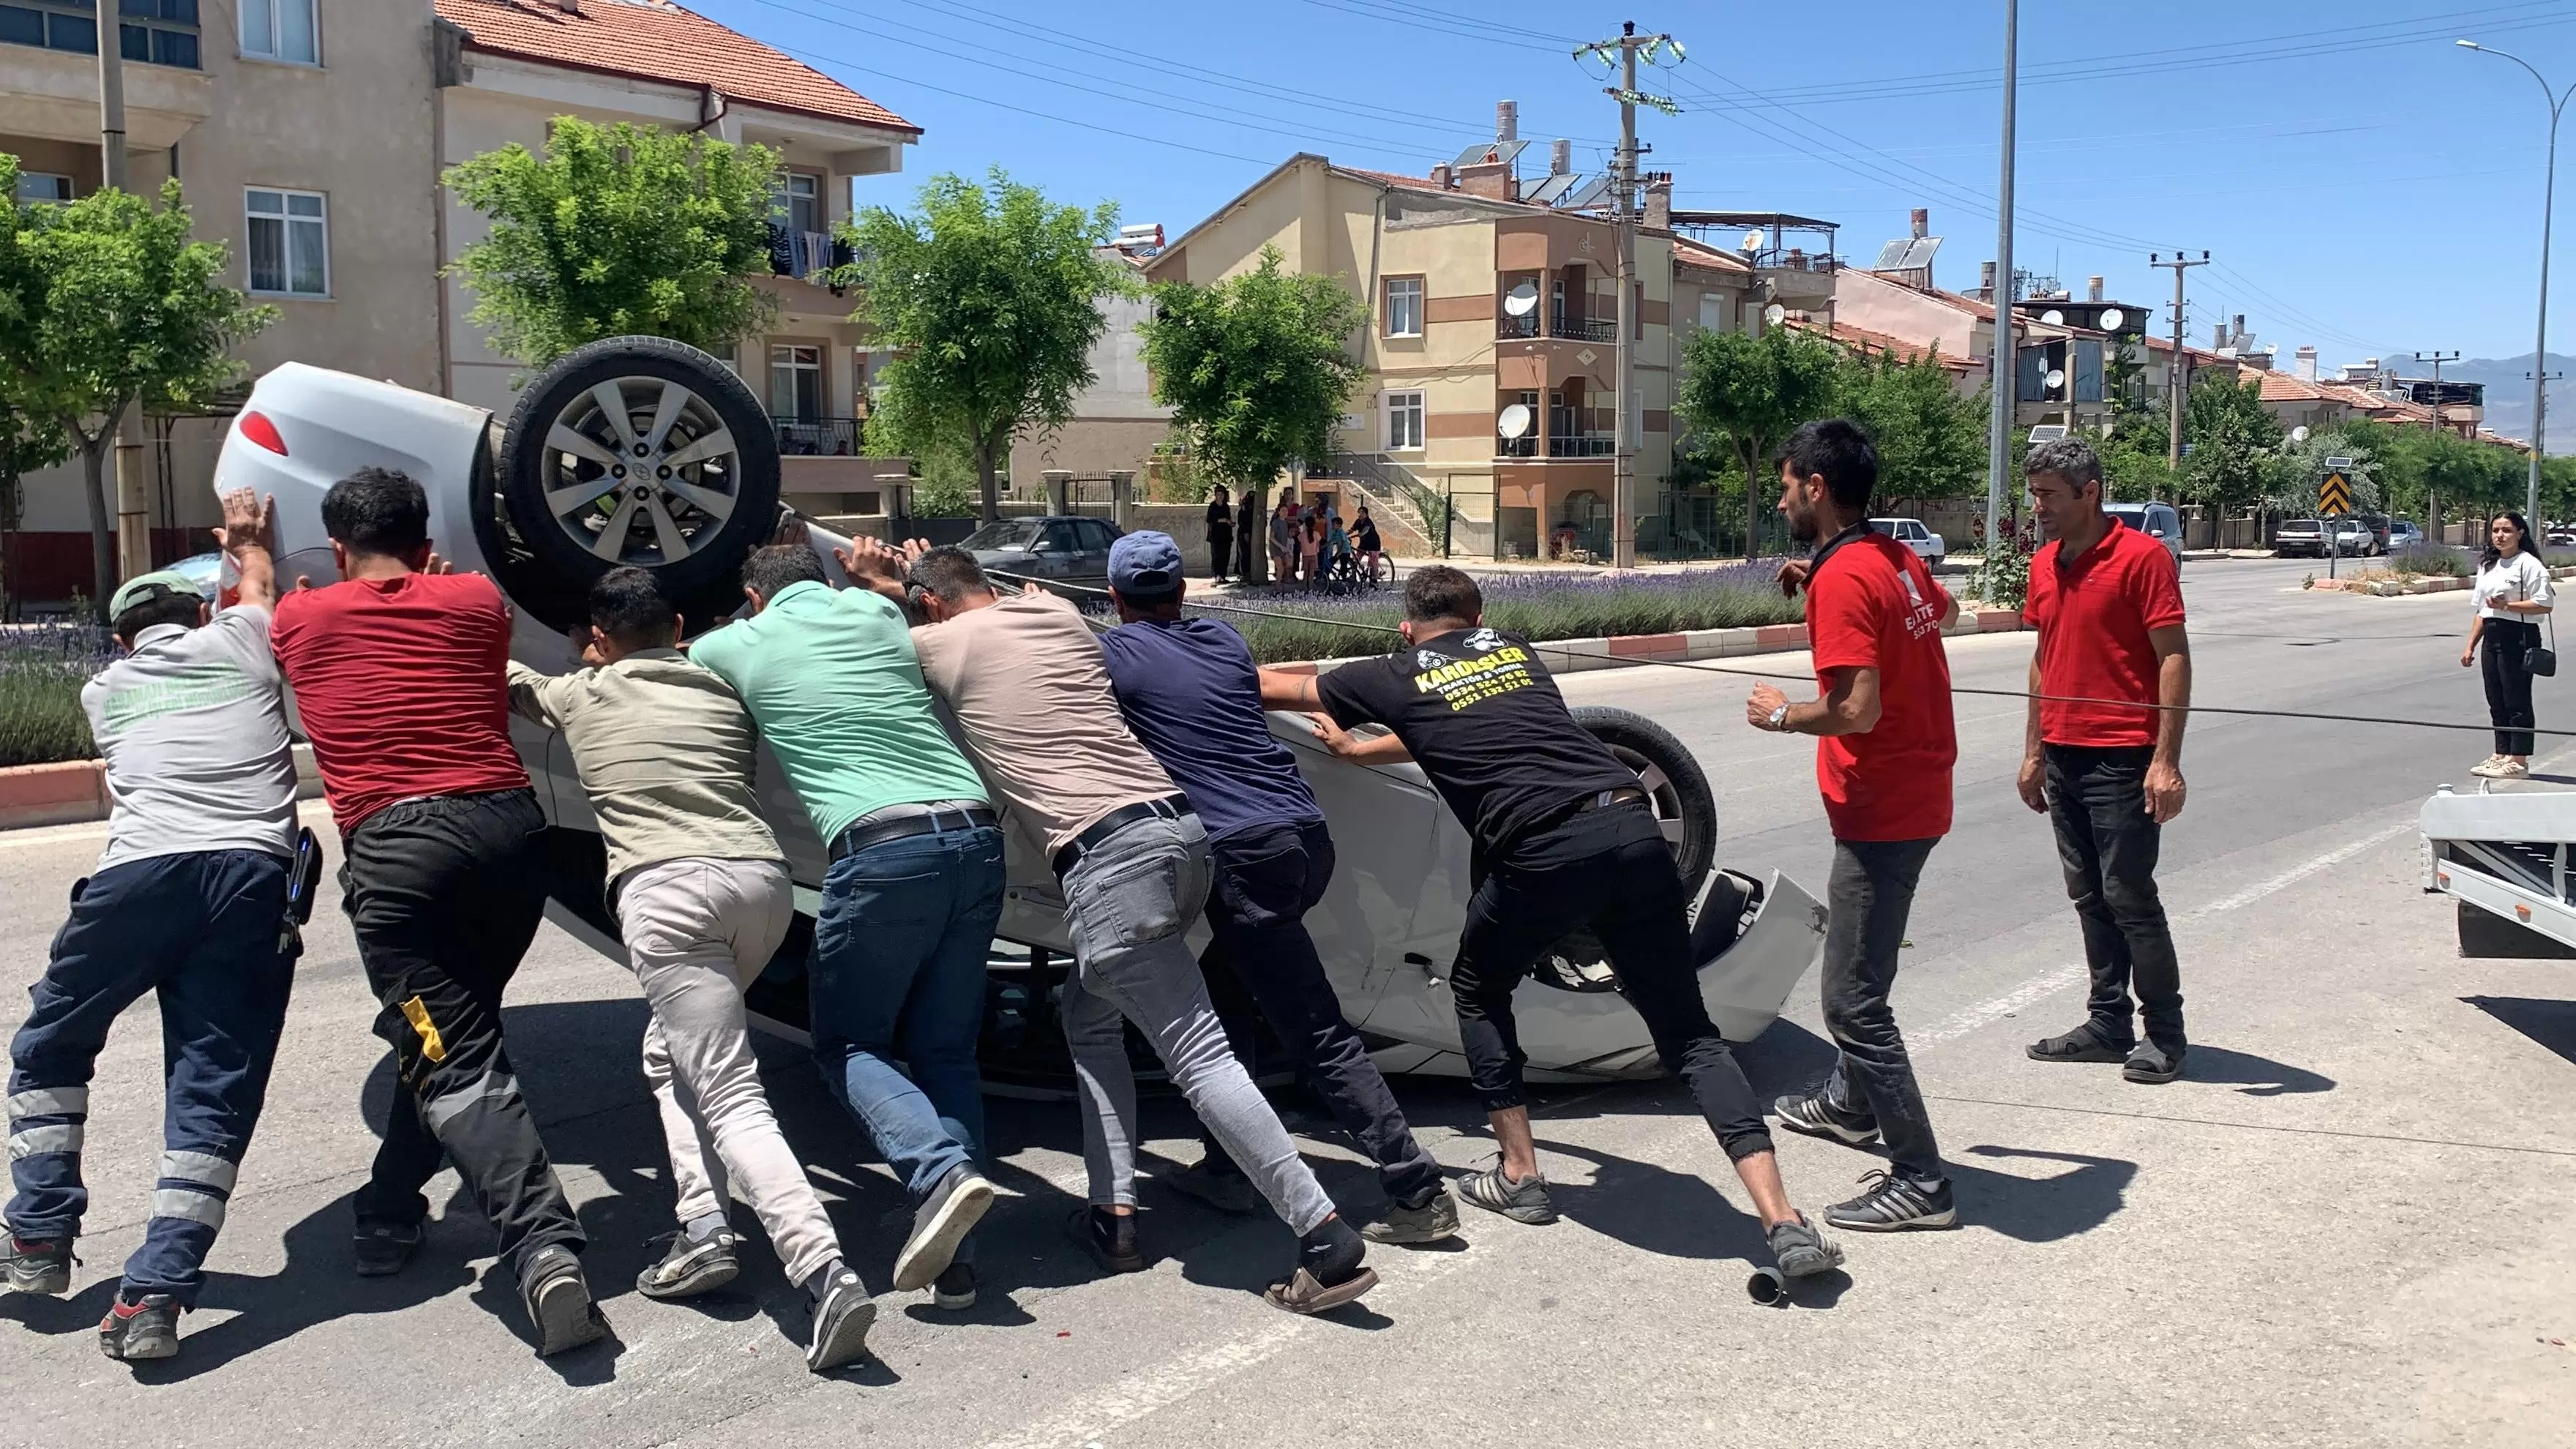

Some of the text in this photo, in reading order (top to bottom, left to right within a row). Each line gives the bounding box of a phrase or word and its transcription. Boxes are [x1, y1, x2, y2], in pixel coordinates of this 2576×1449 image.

[1414, 647, 1529, 694] KARDEŞLER
[1483, 671, 1493, 679] &
[1445, 684, 1475, 701] 0534
[1475, 679, 1499, 689] 524
[1498, 673, 1514, 683] 76
[1451, 692, 1483, 711] 0551
[1482, 686, 1505, 697] 132
[1504, 681, 1521, 691] 51
